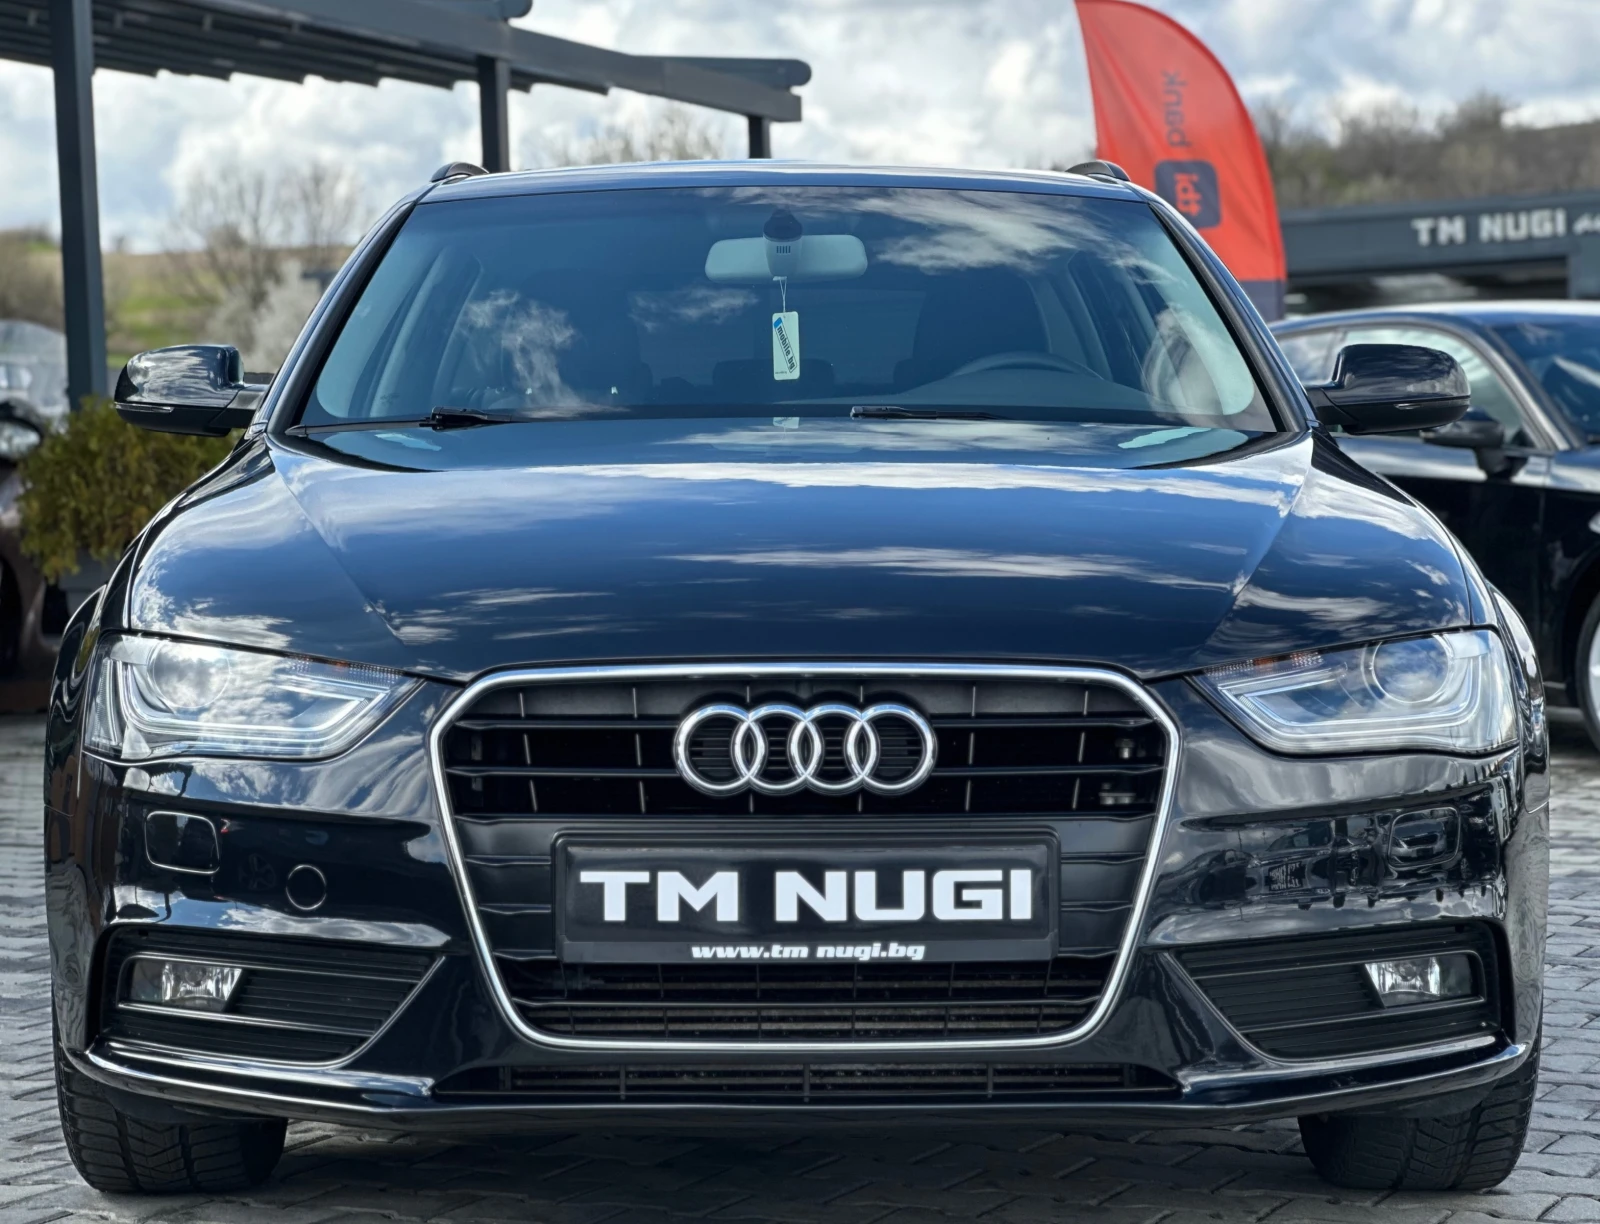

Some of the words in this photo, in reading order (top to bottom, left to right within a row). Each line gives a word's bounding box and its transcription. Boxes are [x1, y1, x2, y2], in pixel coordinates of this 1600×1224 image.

[1410, 215, 1467, 247] TM
[1478, 207, 1567, 243] NUGI
[776, 325, 796, 370] mobile.bg
[579, 870, 739, 922] TM
[774, 869, 1032, 922] NUGI
[691, 943, 809, 959] www.tm
[816, 942, 926, 962] nugi.bg
